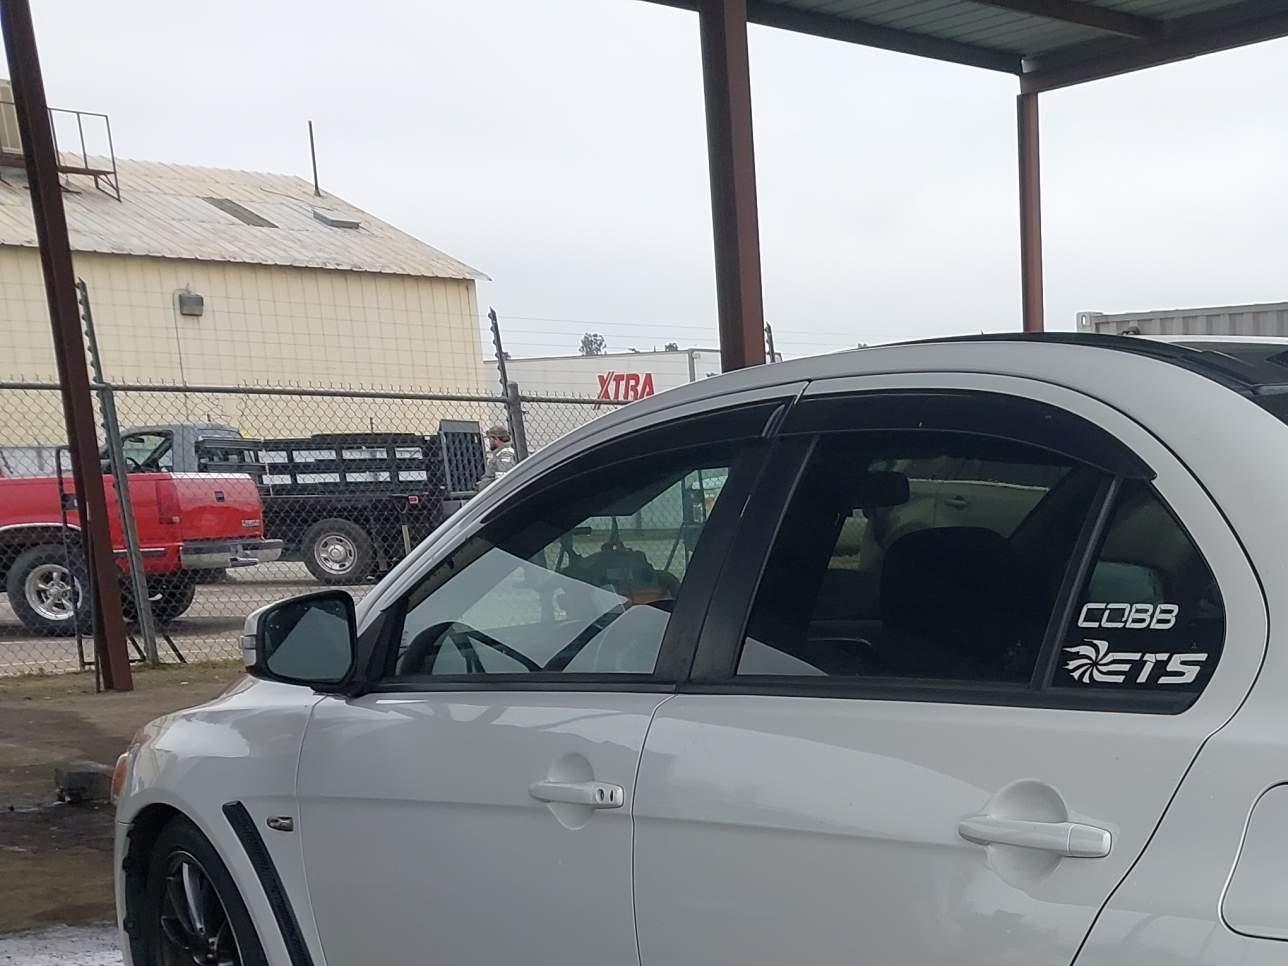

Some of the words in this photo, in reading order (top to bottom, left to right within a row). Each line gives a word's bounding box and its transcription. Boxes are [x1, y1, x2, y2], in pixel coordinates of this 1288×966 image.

[596, 371, 655, 403] XTRA
[1077, 603, 1179, 629] COBB
[1093, 652, 1208, 684] ETS
